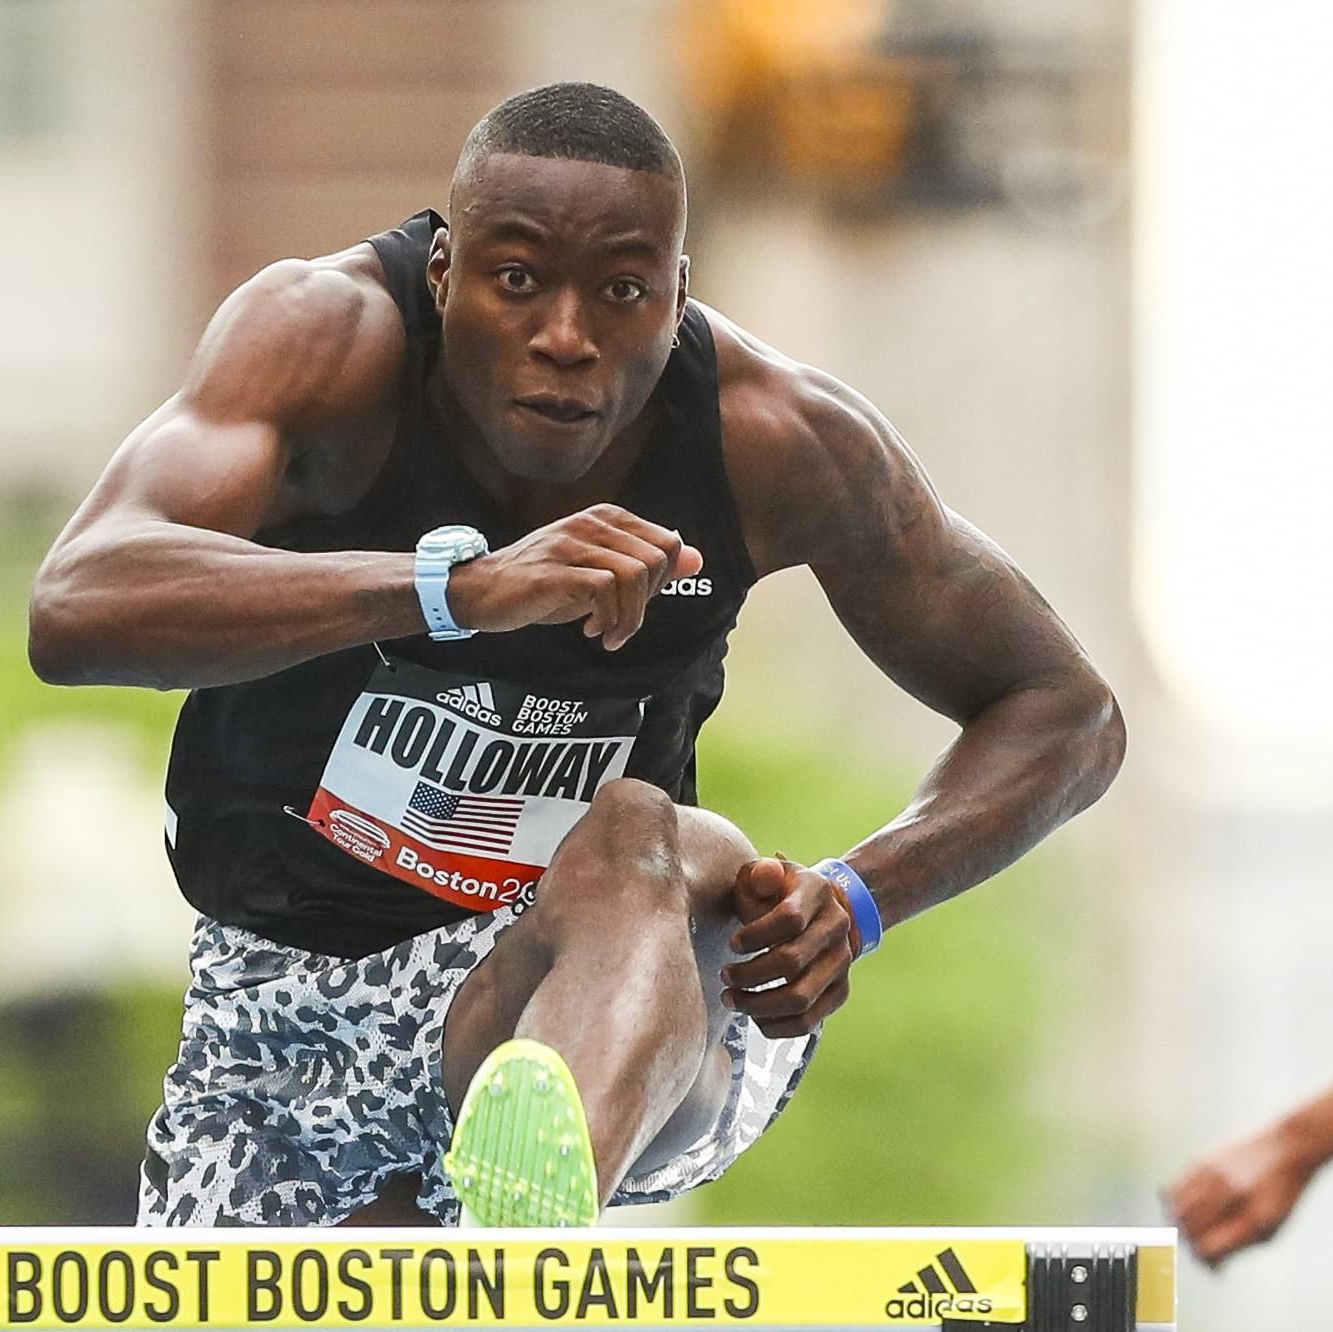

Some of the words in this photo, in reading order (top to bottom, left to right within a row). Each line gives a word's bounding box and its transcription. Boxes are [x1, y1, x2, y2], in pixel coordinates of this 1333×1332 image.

[436, 692, 503, 727] adidas
[517, 707, 588, 724] BOSTON
[523, 693, 584, 713] BOOST
[511, 719, 573, 735] GAMES
[353, 697, 622, 803] HOLLOWAY
[330, 823, 384, 857] Continental
[333, 833, 352, 849] Tour
[352, 845, 374, 862] Gold
[7, 1250, 221, 1324] BOOST
[247, 1248, 505, 1322] BOSTON
[533, 1246, 760, 1320] GAMES
[885, 1292, 993, 1319] adidas
